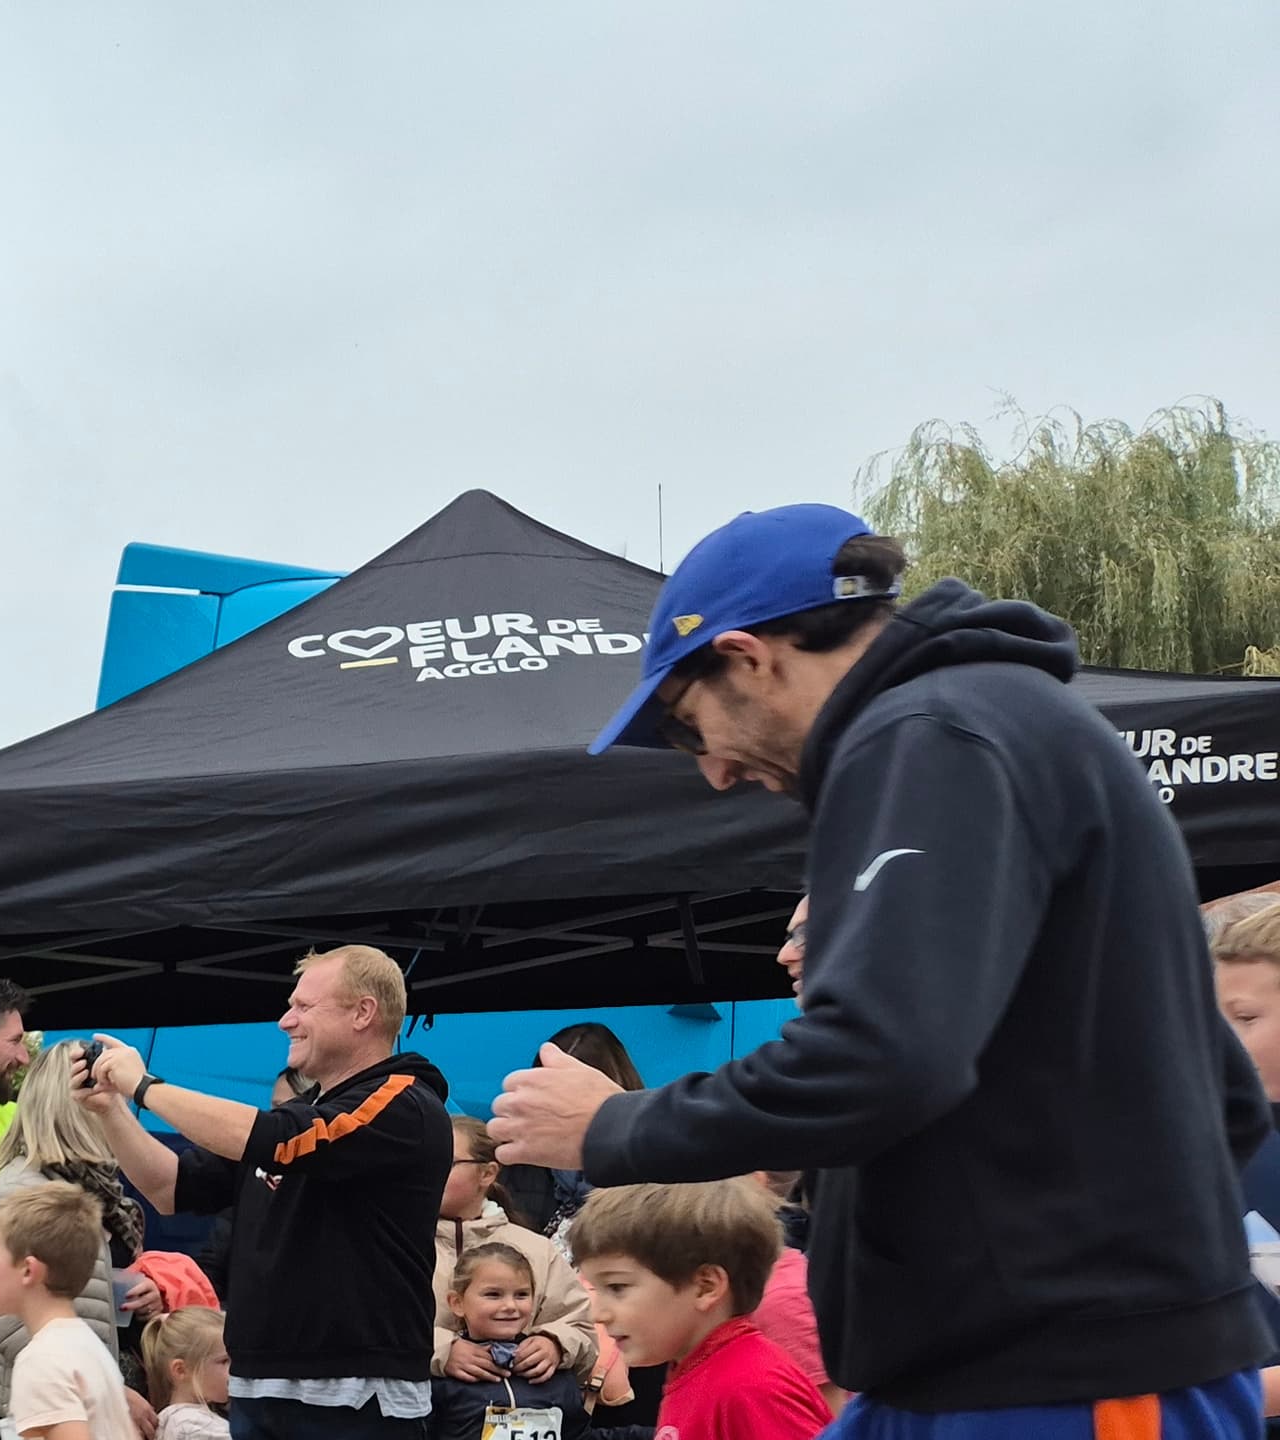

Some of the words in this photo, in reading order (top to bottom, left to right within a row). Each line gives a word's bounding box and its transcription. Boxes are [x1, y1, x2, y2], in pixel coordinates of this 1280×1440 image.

[547, 618, 604, 635] DE
[408, 633, 652, 668] FLAND
[415, 657, 549, 682] AGGLO
[1181, 735, 1213, 755] DE
[1146, 752, 1279, 785] ANDRE
